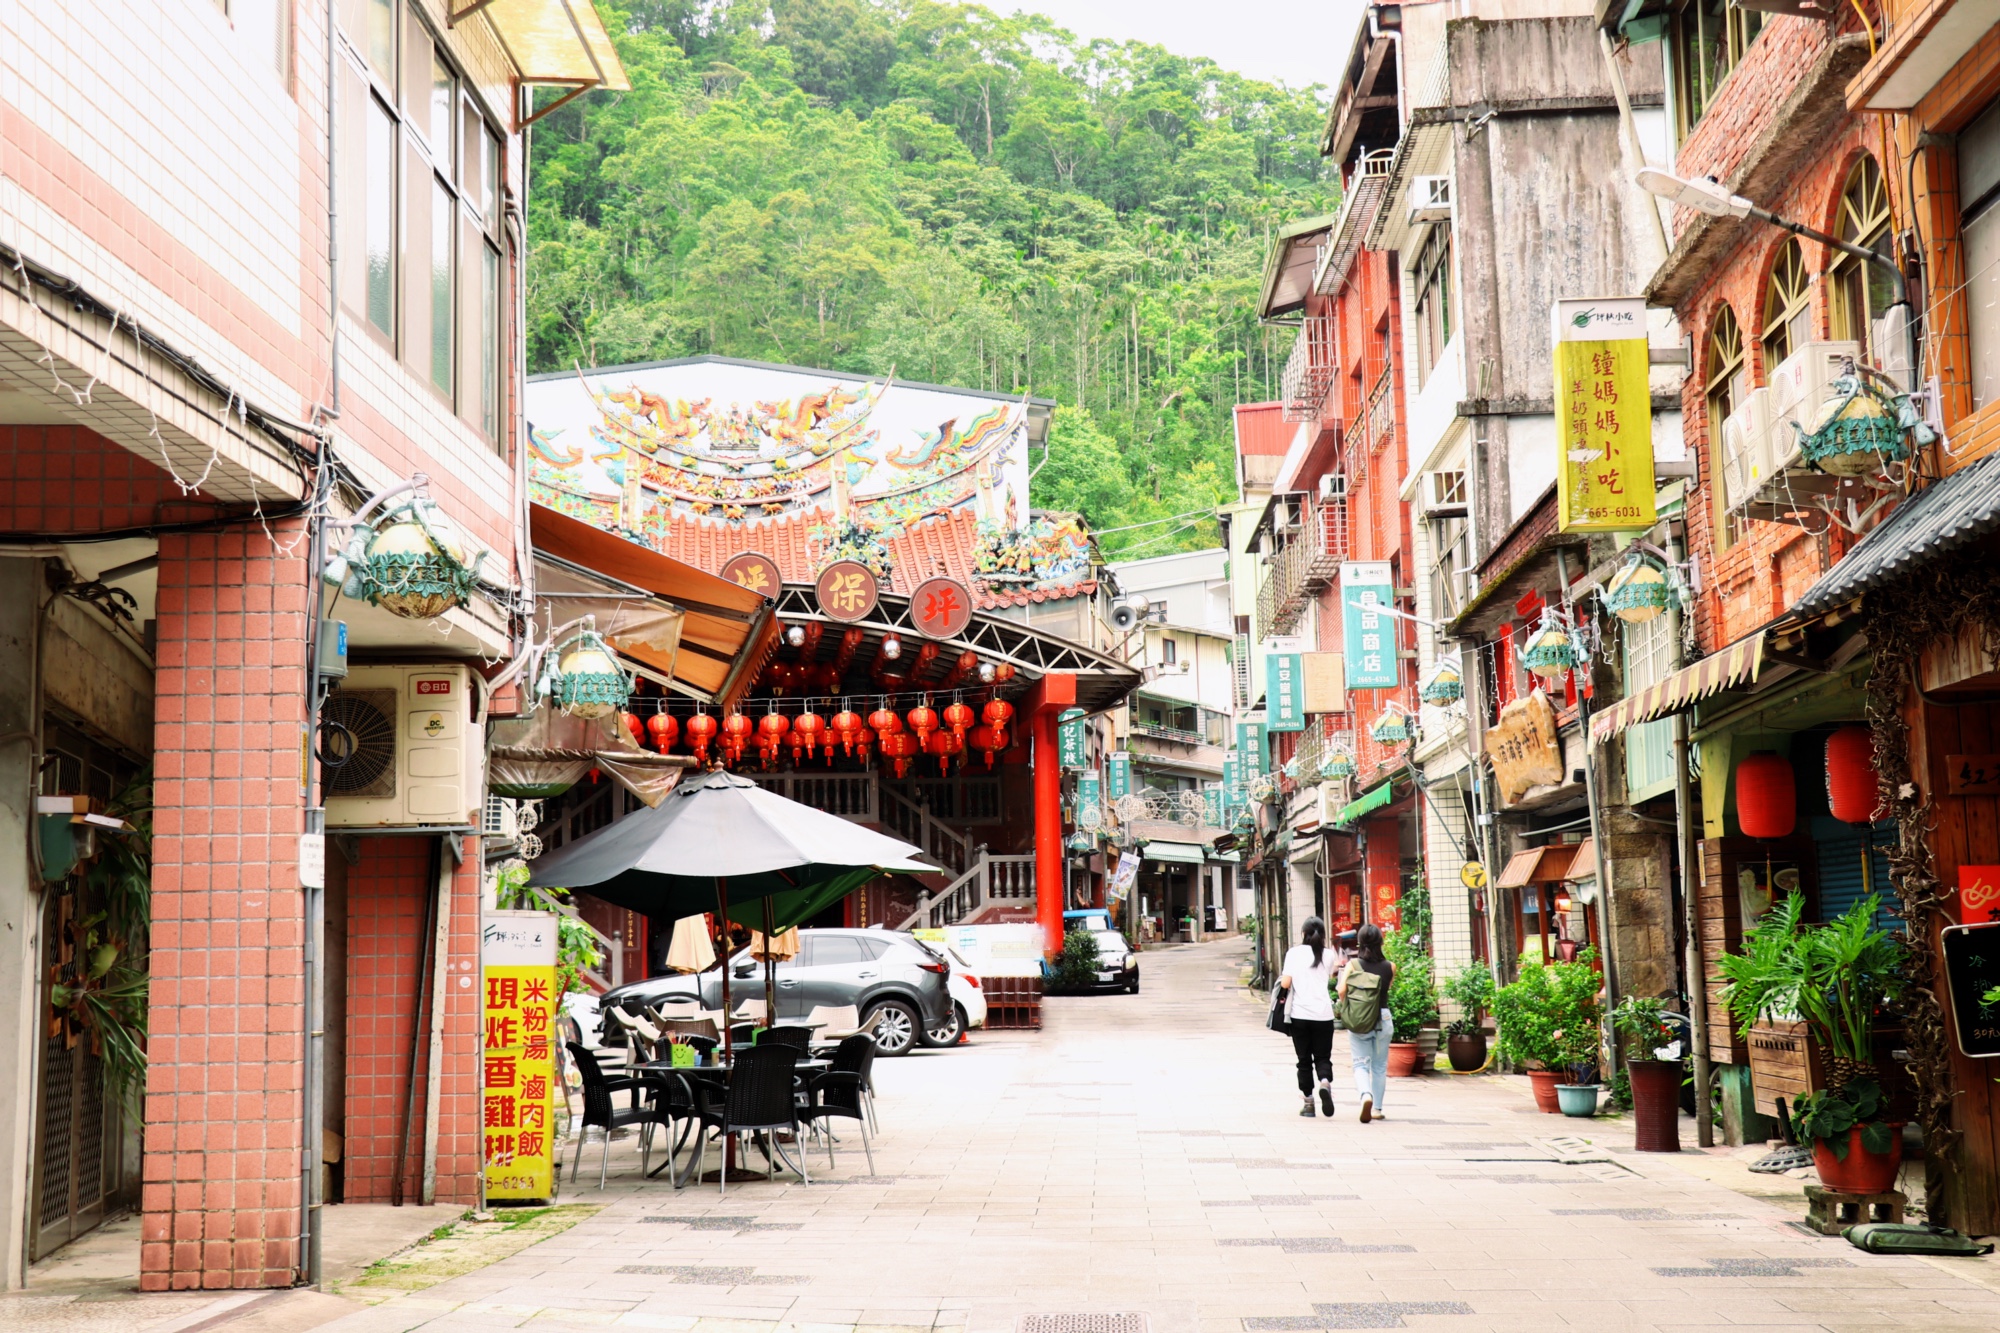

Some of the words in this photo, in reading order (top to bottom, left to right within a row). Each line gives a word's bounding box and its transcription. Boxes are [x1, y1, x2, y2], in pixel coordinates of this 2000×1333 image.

[1591, 350, 1624, 495] 鐘媽媽小吃
[829, 571, 866, 612] 保
[922, 587, 961, 627] 坪
[1360, 590, 1382, 672] 食品商店
[433, 683, 448, 691] 日立
[522, 977, 549, 1061] 米粉湯
[484, 977, 518, 1168] 現炸香雞排
[517, 1073, 547, 1158] 滷肉飯
